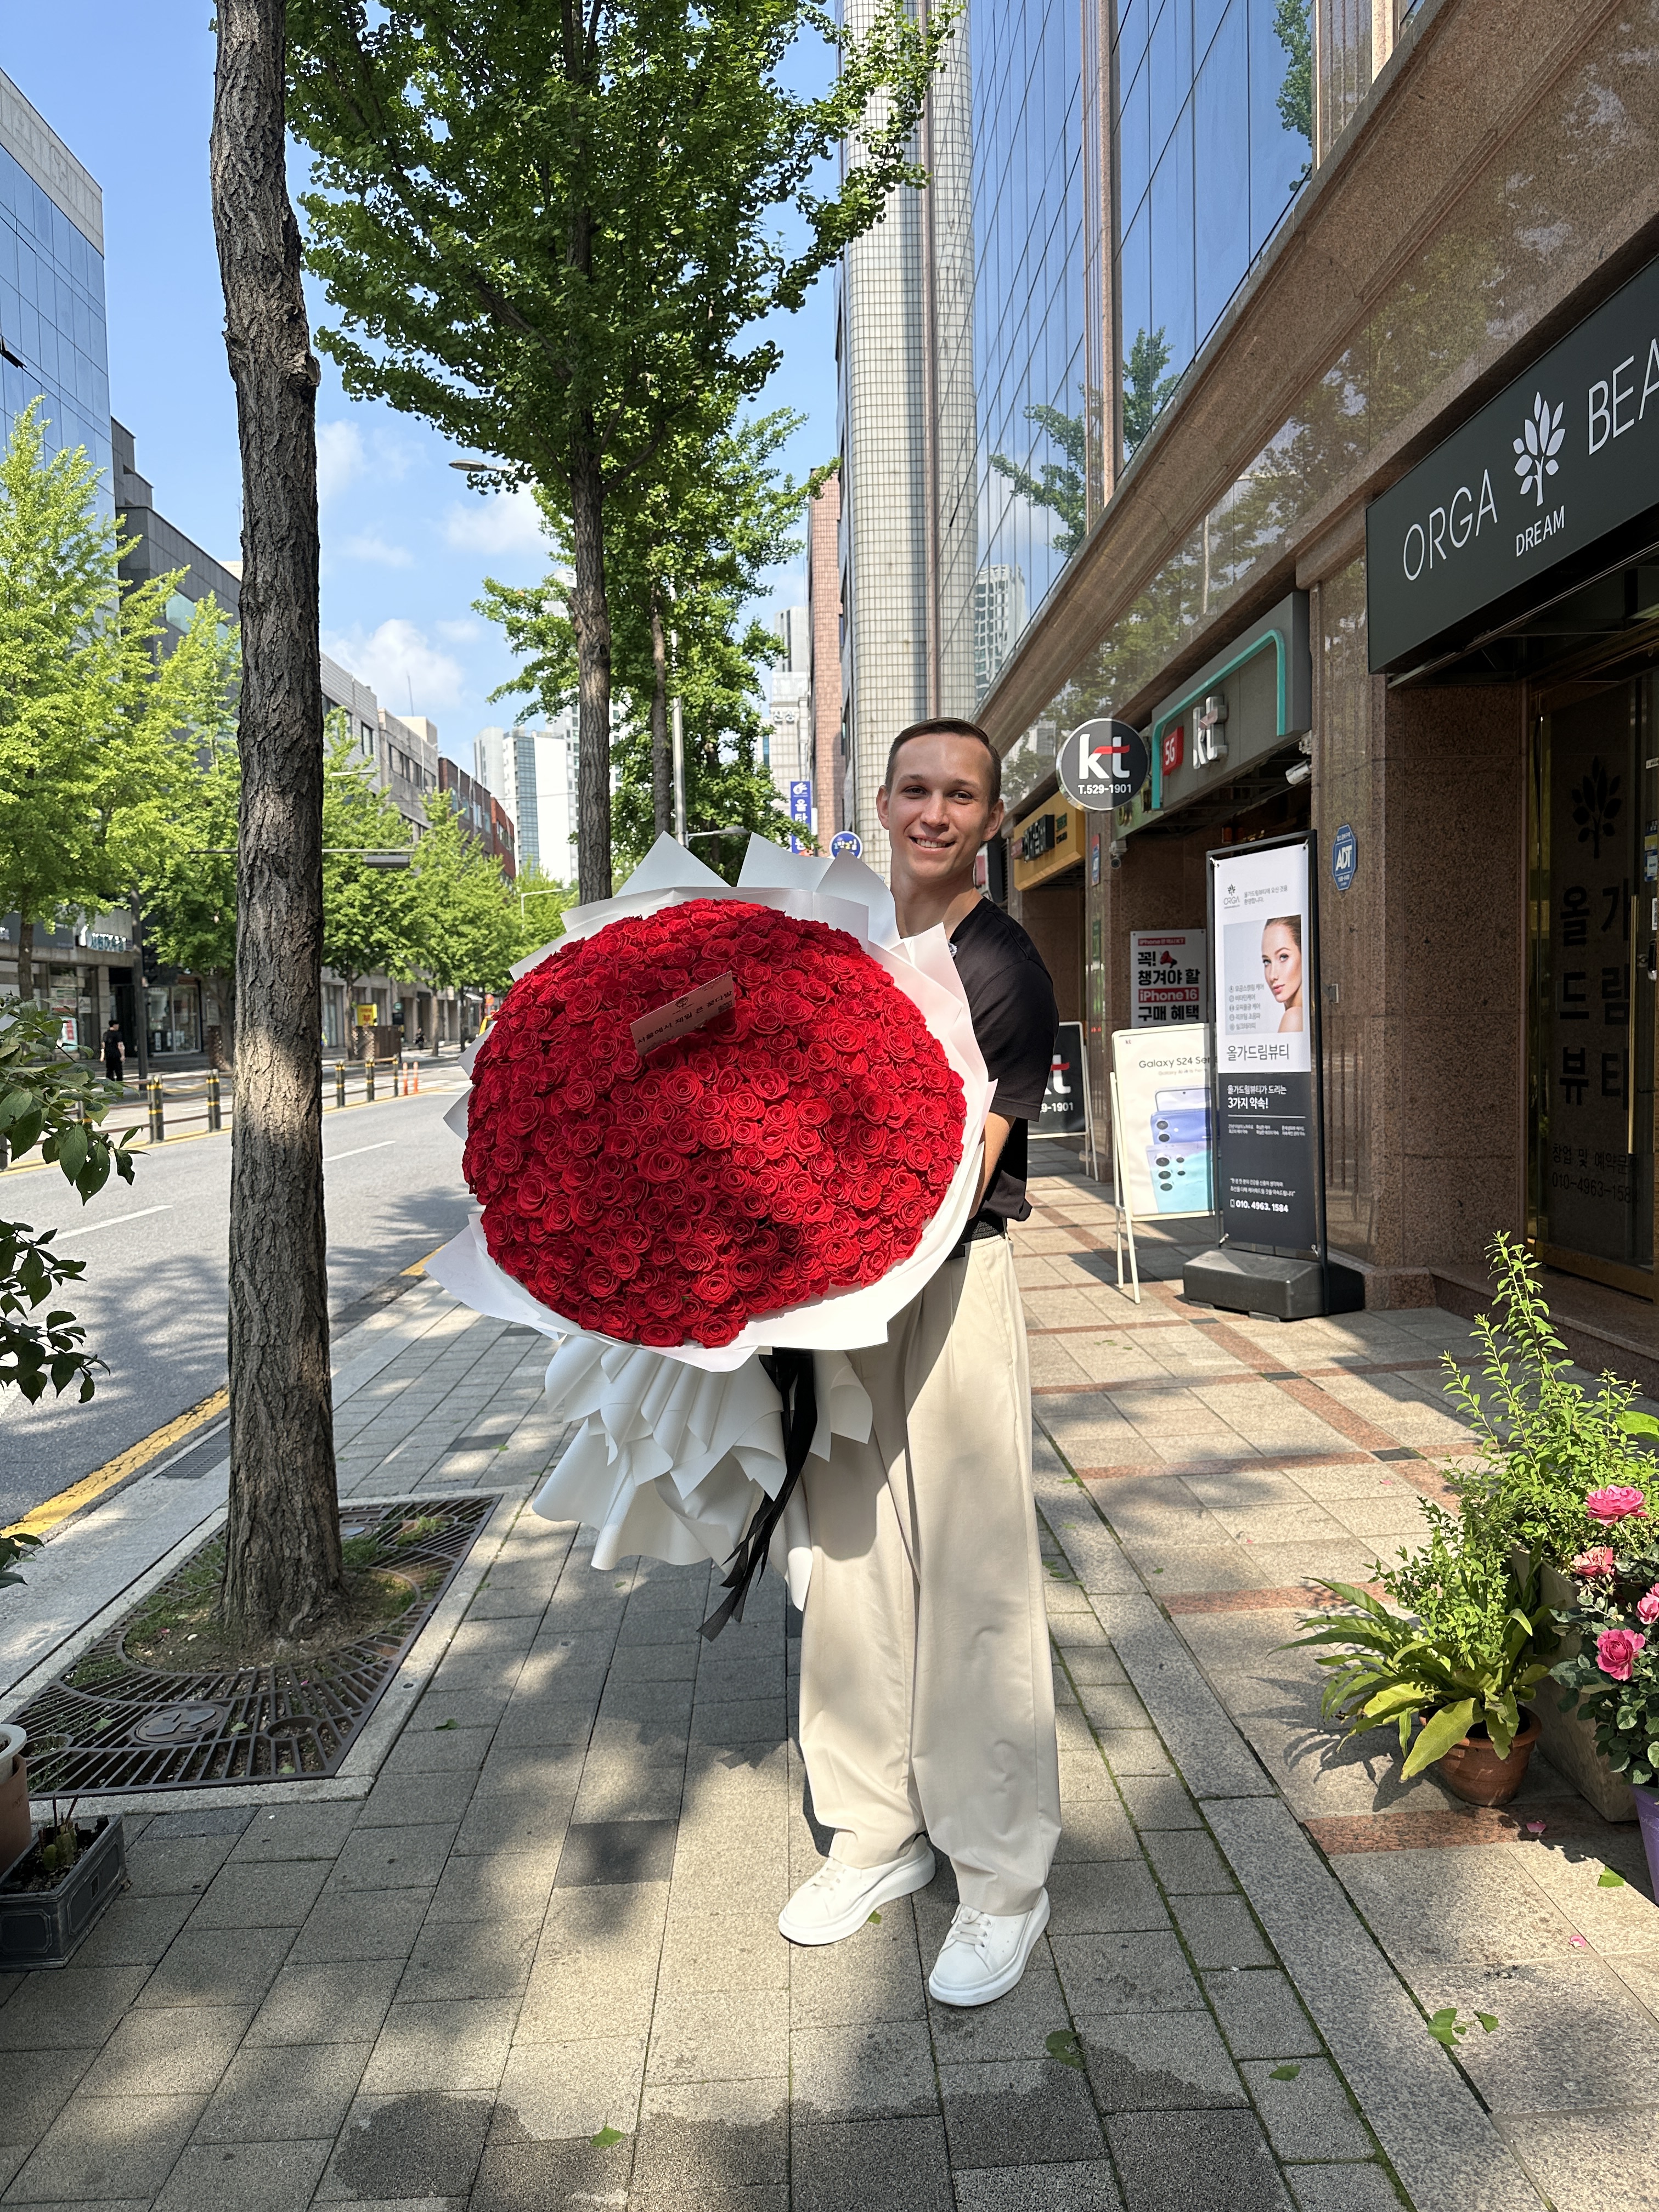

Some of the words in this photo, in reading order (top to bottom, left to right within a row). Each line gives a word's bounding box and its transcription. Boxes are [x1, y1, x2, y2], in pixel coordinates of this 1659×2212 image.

[1403, 469, 1498, 581] ORGA
[1515, 505, 1565, 557] DREAM
[1193, 696, 1227, 769] kt
[1079, 733, 1130, 780] kt
[1165, 737, 1175, 766] 5G
[1077, 783, 1132, 794] T.529-1901
[1335, 844, 1352, 871] ADT
[1223, 896, 1240, 905] ORGA
[1138, 951, 1156, 967] 꼭!
[1138, 969, 1183, 986] 챙겨야
[1185, 968, 1200, 984] 할
[1139, 990, 1184, 1002] iPhone
[1184, 989, 1198, 1000] 16
[1138, 1006, 1166, 1022] 구매
[1171, 1005, 1199, 1020] 혜택
[1226, 1043, 1289, 1062] 올가드림뷰티
[1139, 1059, 1175, 1068] Galaxy
[1176, 1057, 1193, 1066] S24
[1268, 1084, 1288, 1095] 드리는
[1040, 1102, 1074, 1113] 9-1901
[1227, 1097, 1249, 1109] 3가지
[1249, 1097, 1269, 1110] 약속!
[1552, 1143, 1571, 1165] 창업
[1578, 1148, 1587, 1168] 및
[1552, 1171, 1637, 1204] 010-4963-158
[1235, 1199, 1250, 1209] 010.
[1251, 1201, 1271, 1211] 4963.
[1272, 1203, 1289, 1213] 1584
